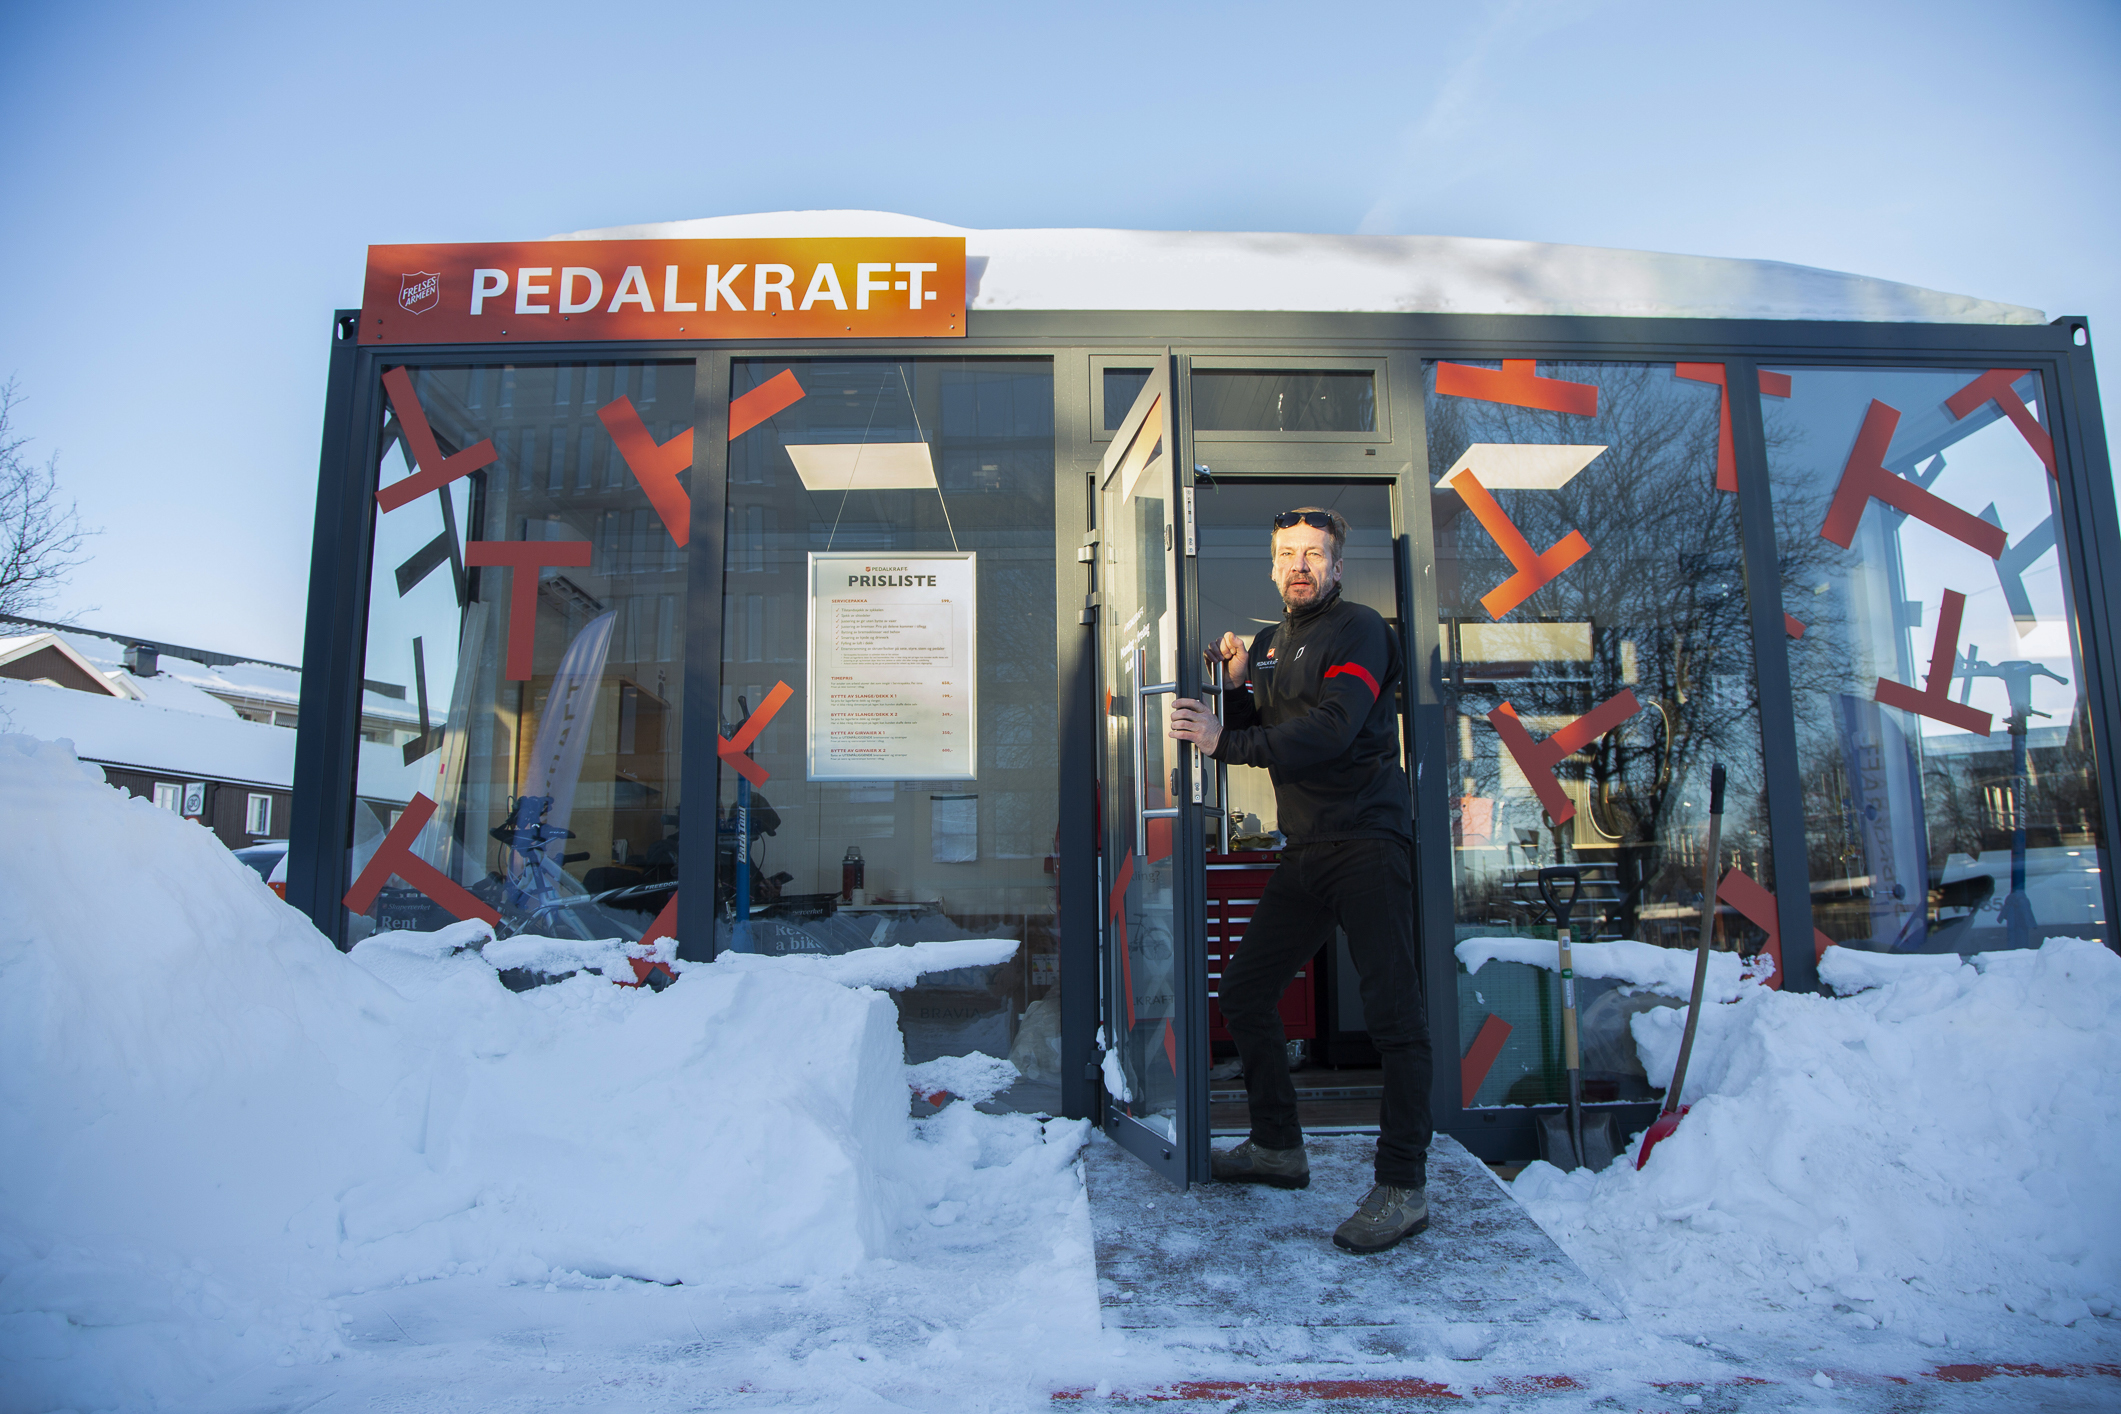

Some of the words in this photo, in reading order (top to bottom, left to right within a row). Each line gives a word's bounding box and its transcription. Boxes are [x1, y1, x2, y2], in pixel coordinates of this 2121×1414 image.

[402, 276, 437, 300] FRELSES
[404, 285, 436, 307] ARMEEN
[470, 262, 937, 317] PEDALKRAFT
[848, 575, 937, 587] PRISLISTE
[737, 834, 746, 864] Park
[381, 915, 417, 930] Rent
[775, 941, 785, 951] a
[920, 1007, 982, 1019] BRAVIA
